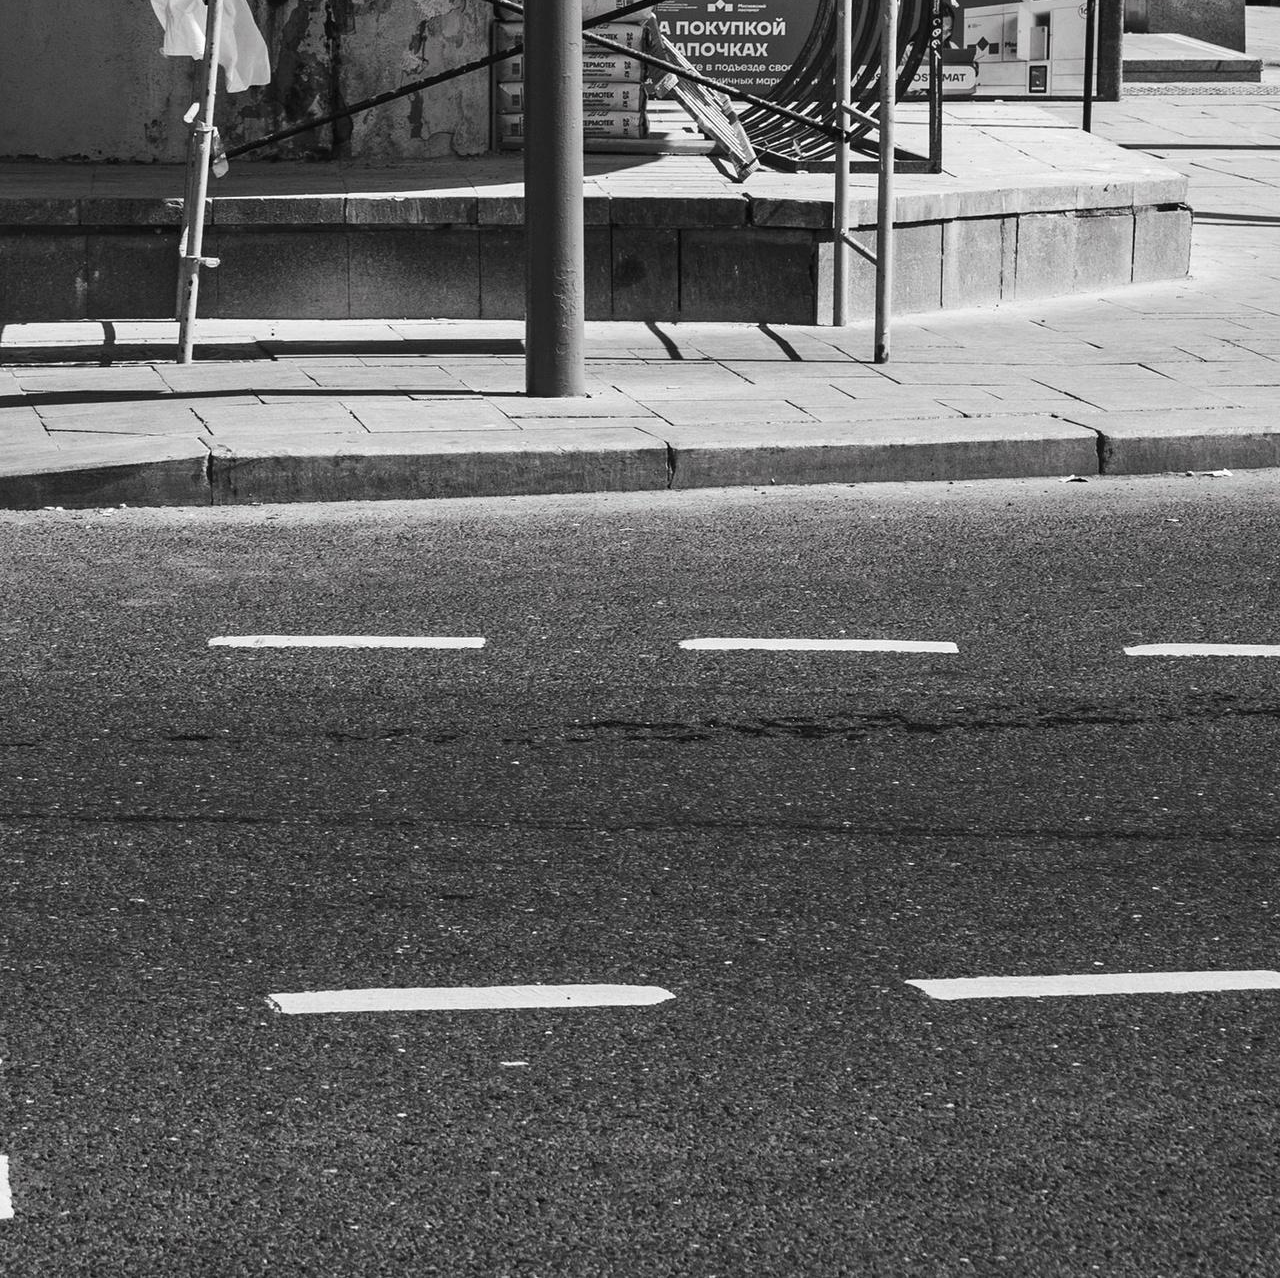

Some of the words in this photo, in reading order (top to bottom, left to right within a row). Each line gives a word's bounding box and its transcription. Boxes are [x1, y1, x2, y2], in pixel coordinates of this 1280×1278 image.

[676, 18, 786, 36] ПОКУПКОЙ
[671, 42, 768, 57] АПОЧКАХ
[715, 64, 766, 73] подъезде
